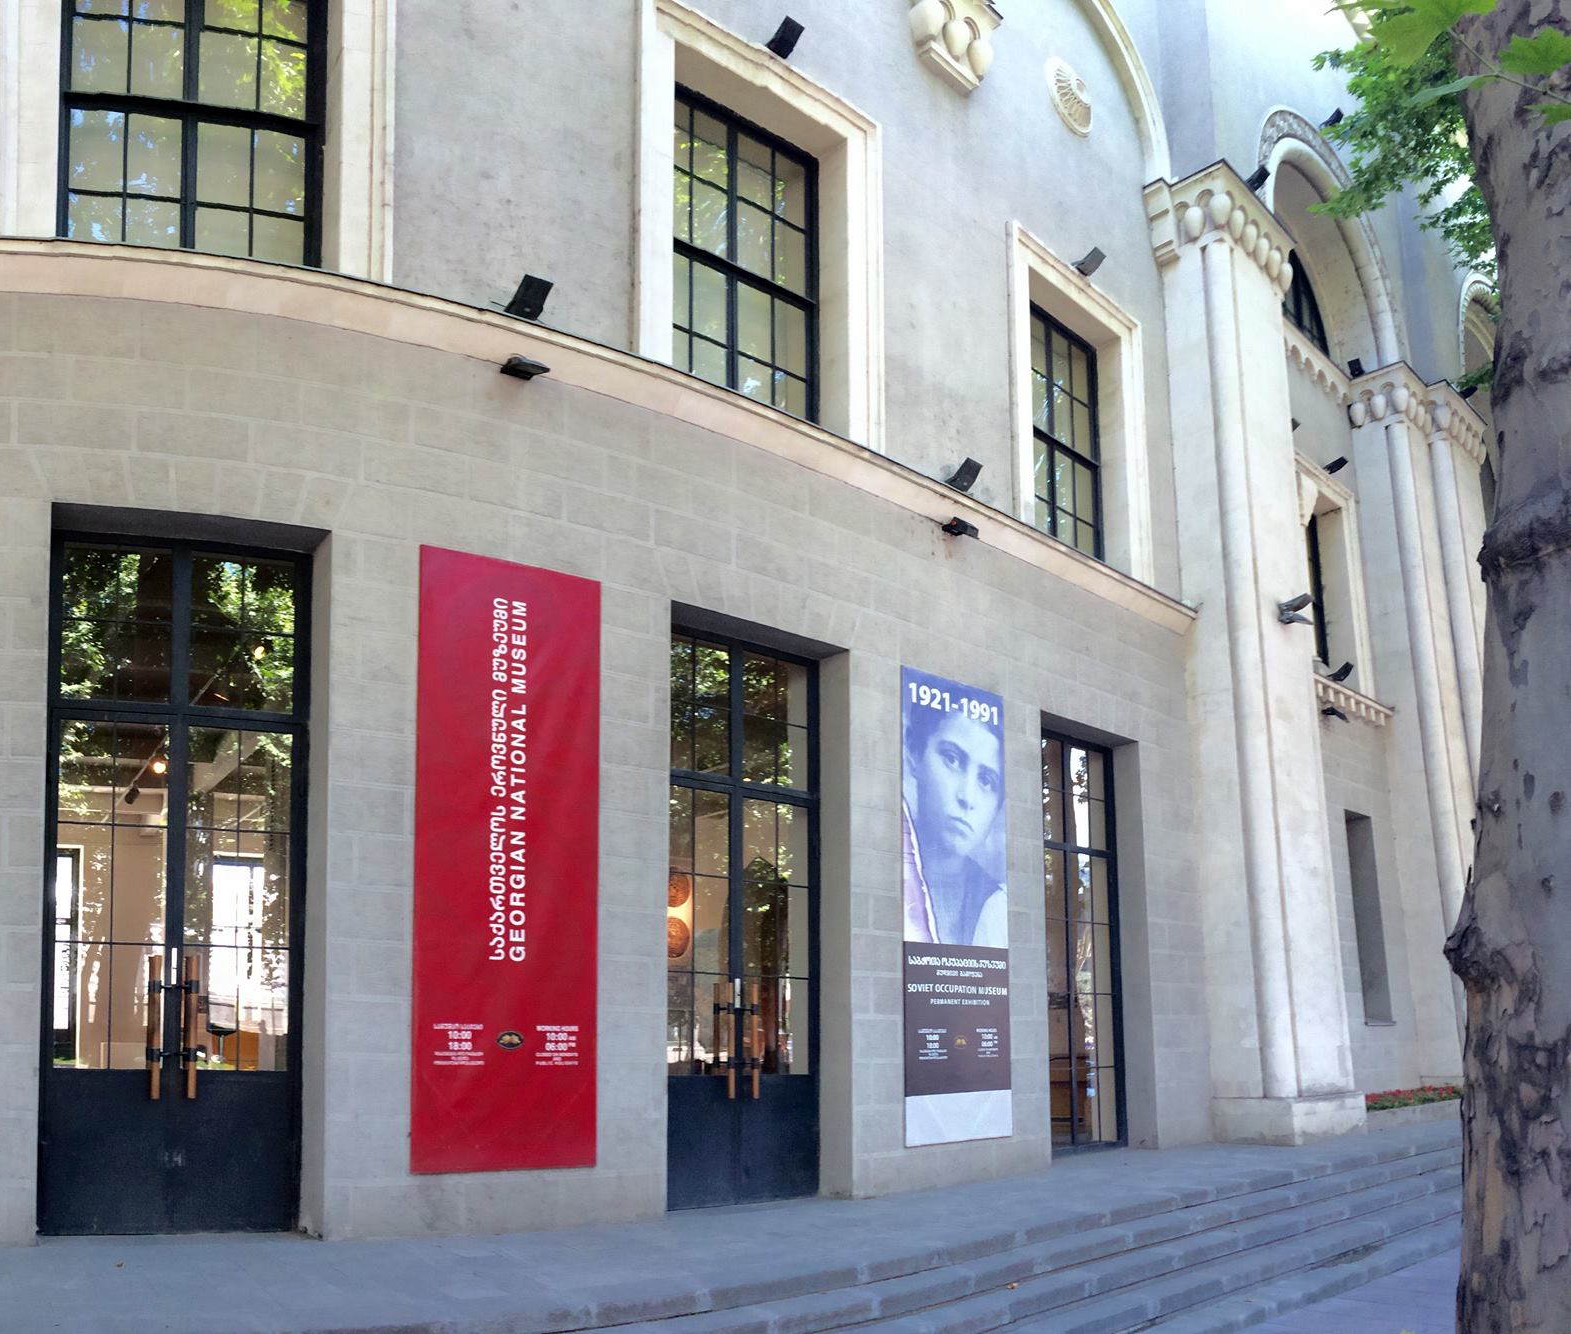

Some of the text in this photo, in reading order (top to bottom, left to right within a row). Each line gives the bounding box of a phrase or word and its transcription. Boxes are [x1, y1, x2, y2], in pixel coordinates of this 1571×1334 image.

[909, 682, 998, 726] 1921-1991
[489, 598, 508, 960] საქართველოს ეროვნული მუზეუმი
[509, 601, 527, 962] GEORGIAN NATIONAL MUSEUM
[907, 983, 933, 992] SOVIET
[448, 1031, 472, 1039] 10:00
